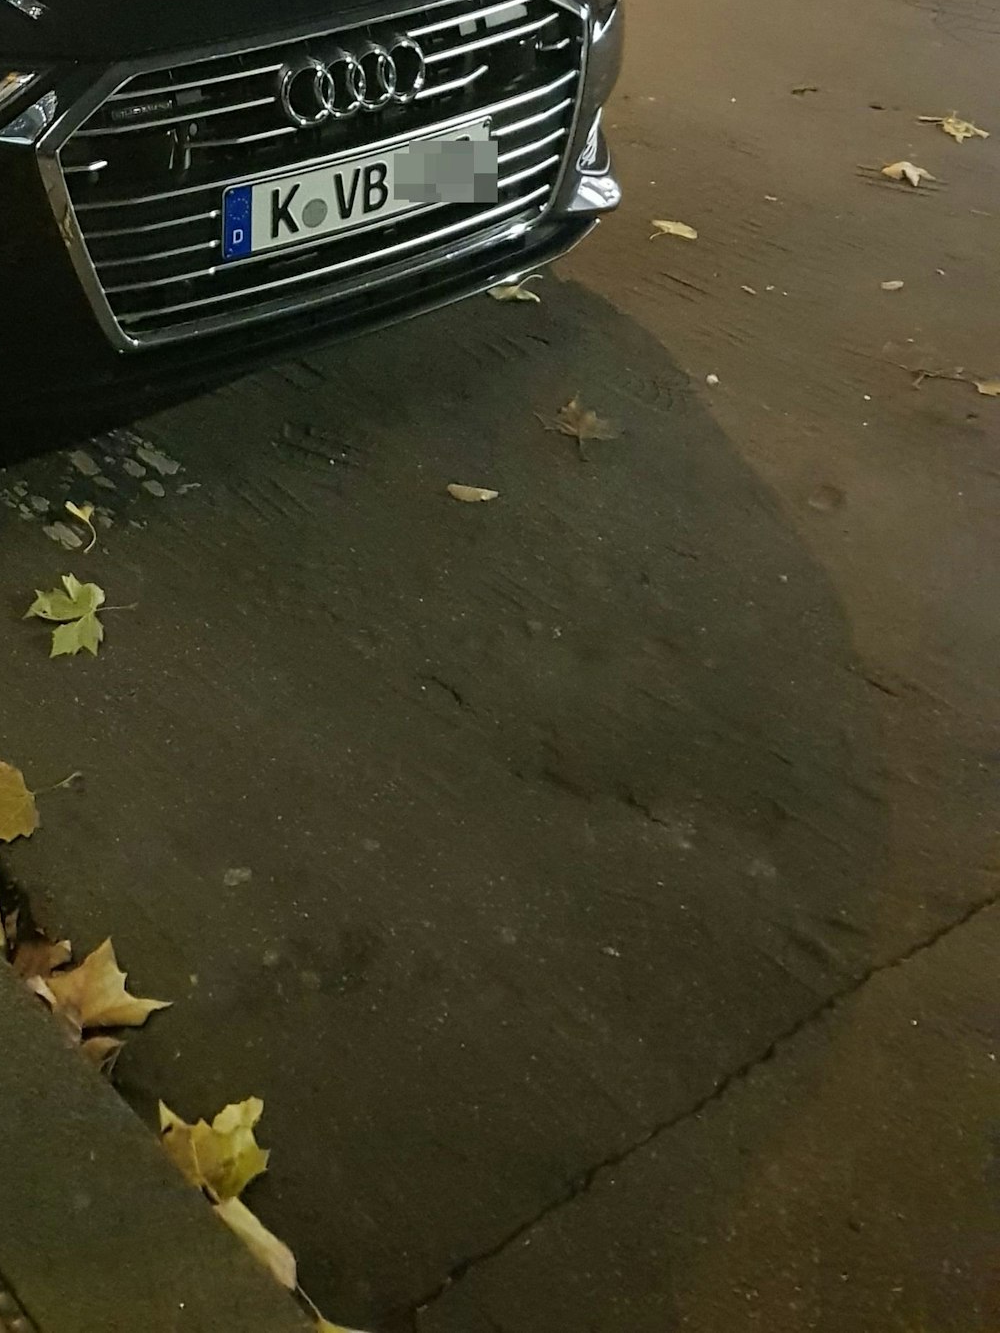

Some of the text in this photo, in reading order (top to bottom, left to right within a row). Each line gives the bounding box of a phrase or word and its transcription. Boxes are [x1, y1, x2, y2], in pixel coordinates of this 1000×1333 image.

[270, 183, 301, 239] K
[333, 161, 389, 220] VB
[232, 229, 244, 244] D
